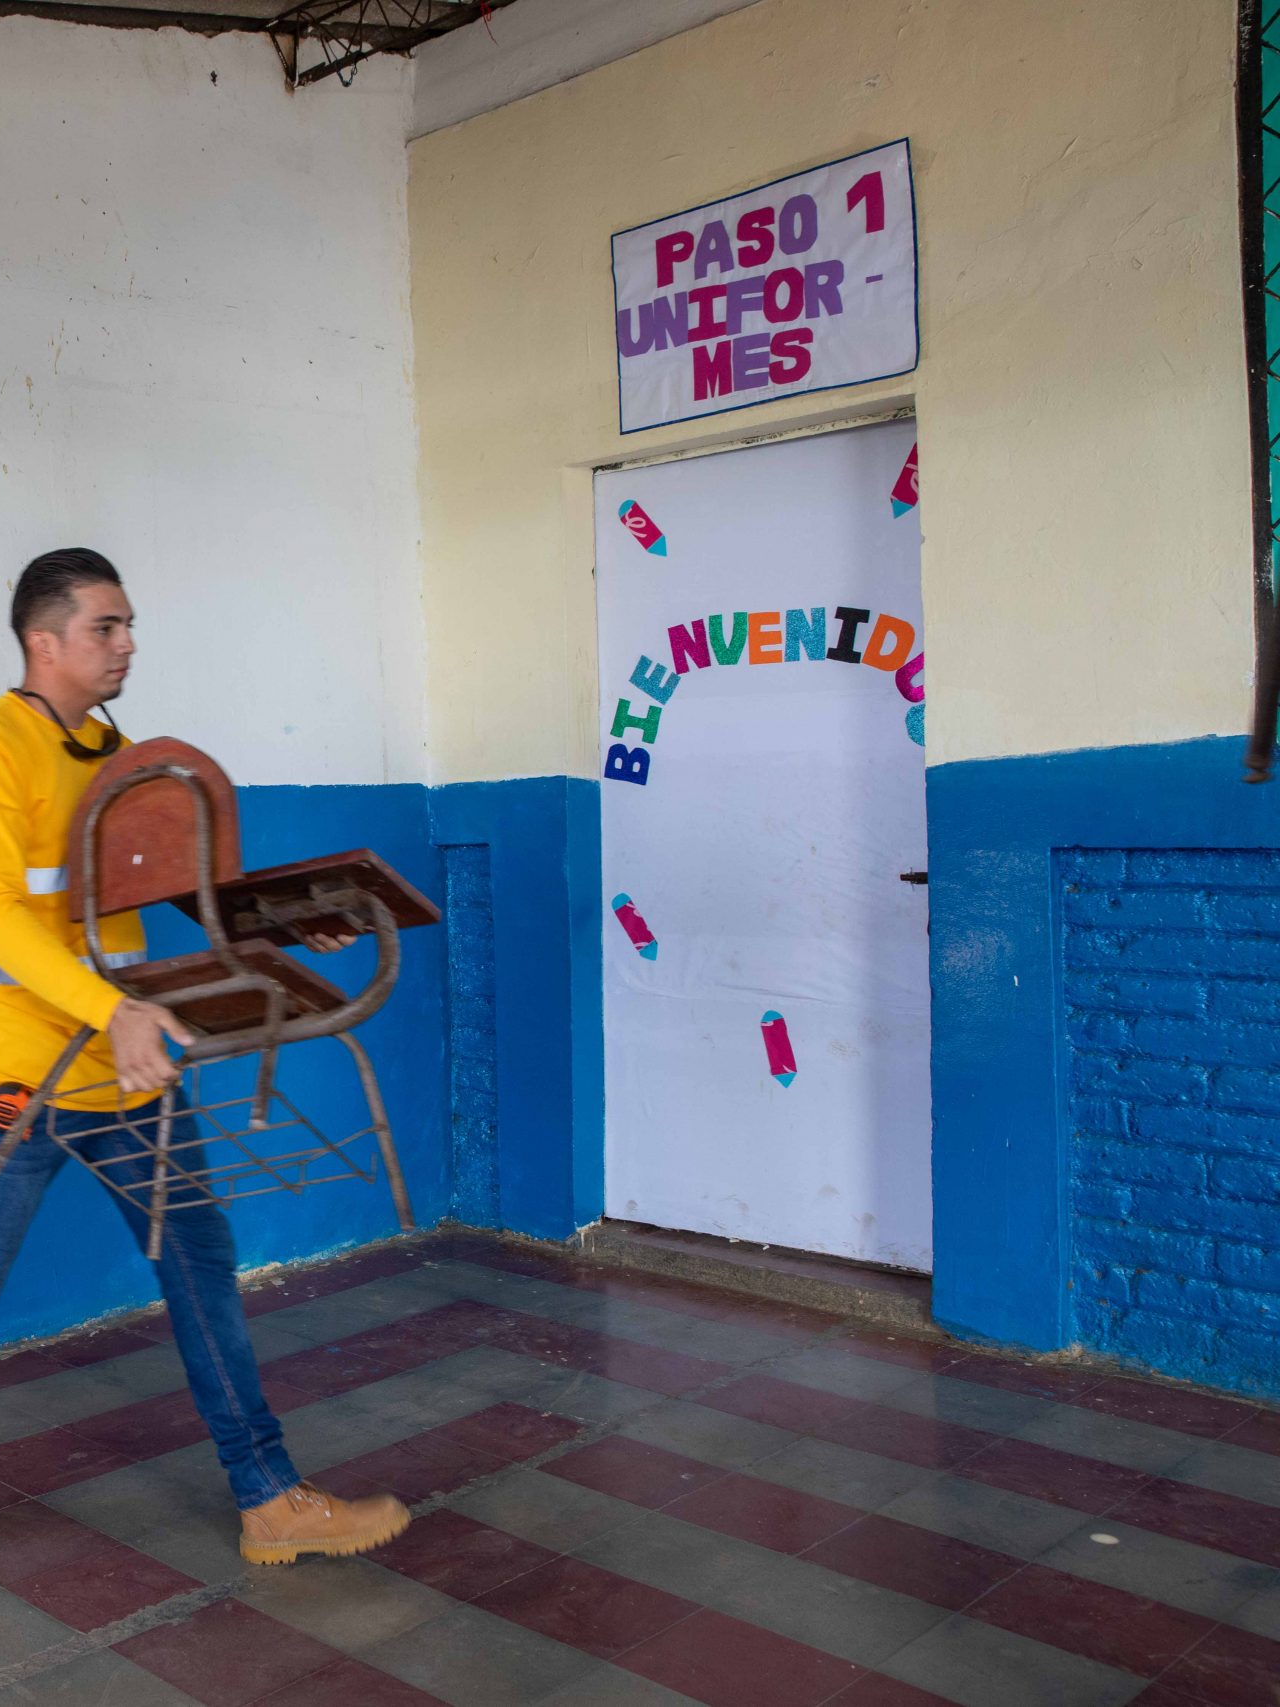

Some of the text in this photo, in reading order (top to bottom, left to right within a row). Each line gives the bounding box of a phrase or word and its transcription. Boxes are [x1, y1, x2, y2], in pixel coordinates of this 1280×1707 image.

[655, 171, 885, 288] PASO 1
[693, 327, 813, 401] MES
